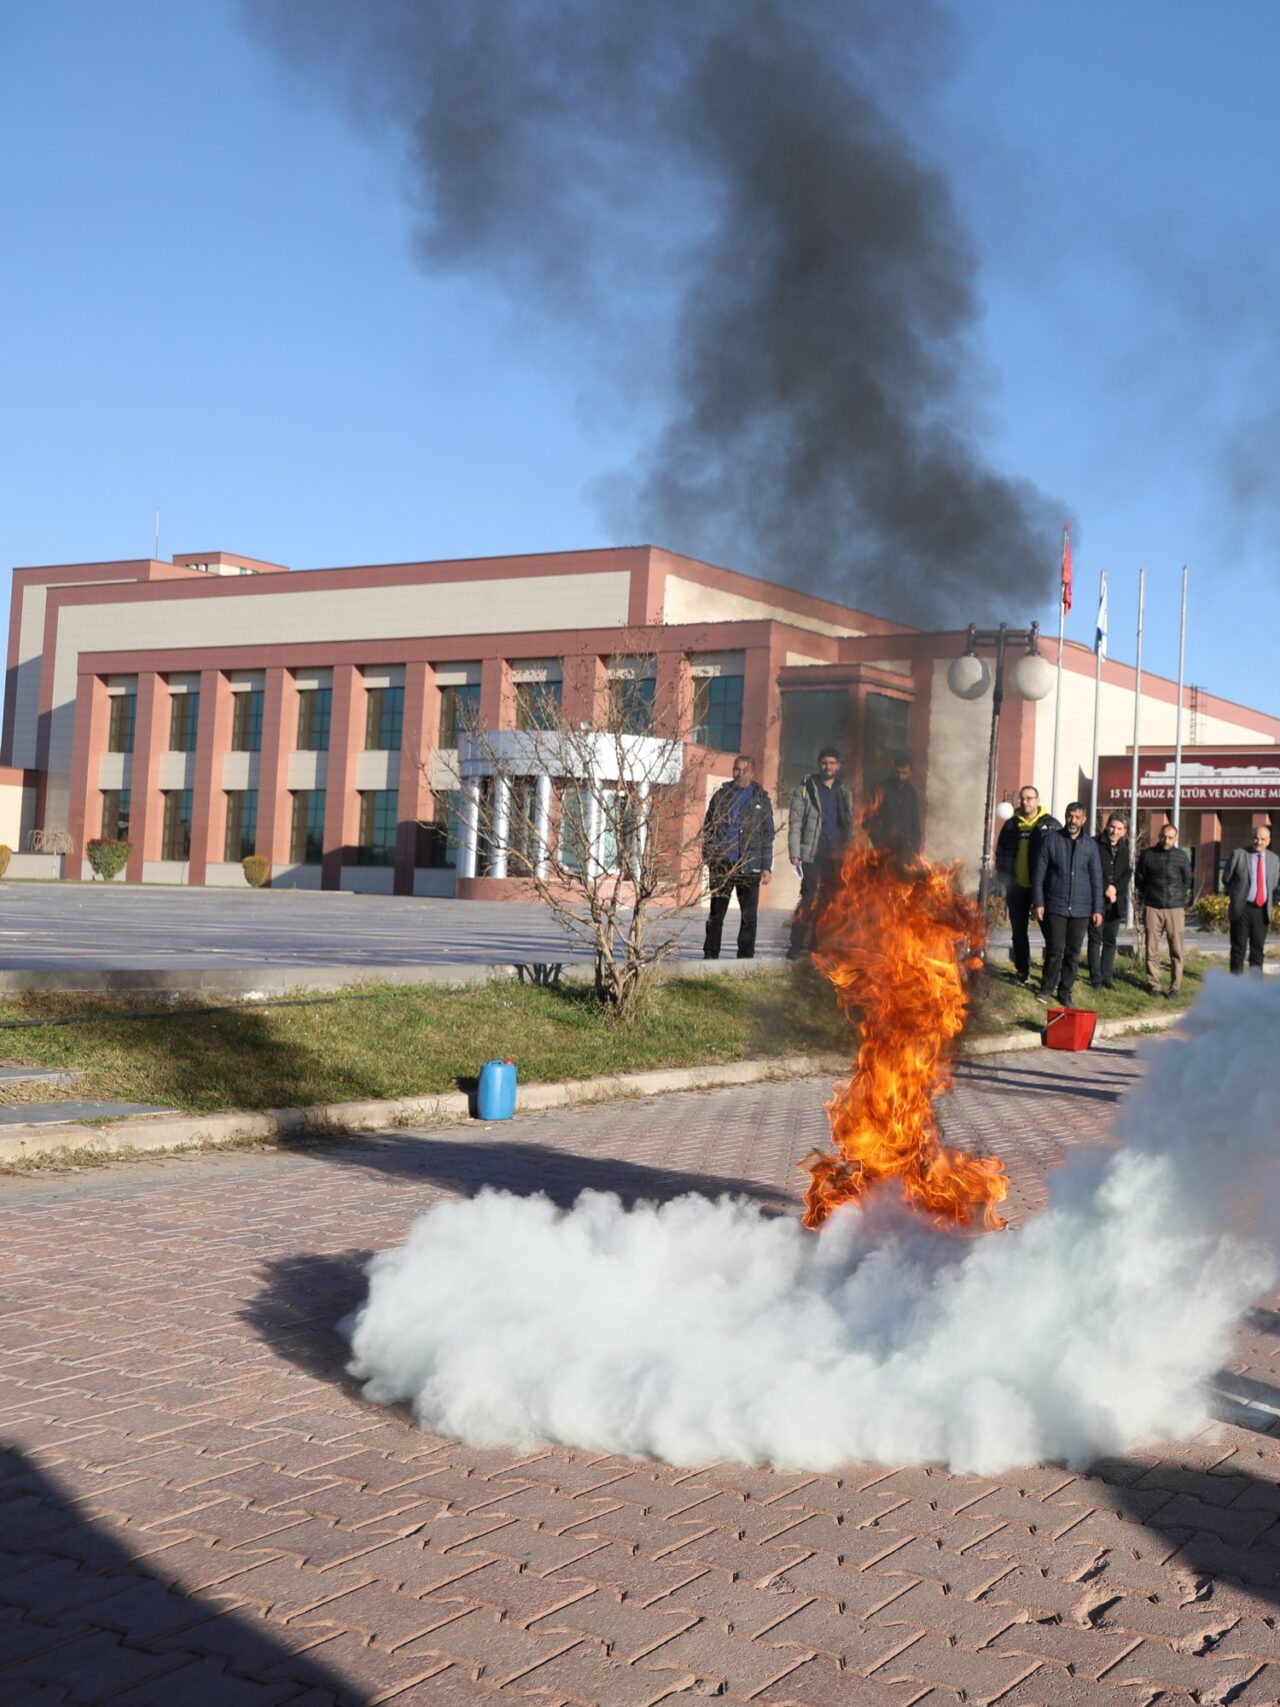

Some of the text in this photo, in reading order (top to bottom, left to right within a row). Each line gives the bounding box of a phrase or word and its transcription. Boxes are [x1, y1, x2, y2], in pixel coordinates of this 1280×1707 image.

[1110, 788, 1120, 798] 15
[1167, 787, 1207, 798] KLTÜR
[1208, 788, 1221, 798] VE
[1223, 788, 1267, 798] KONGRE
